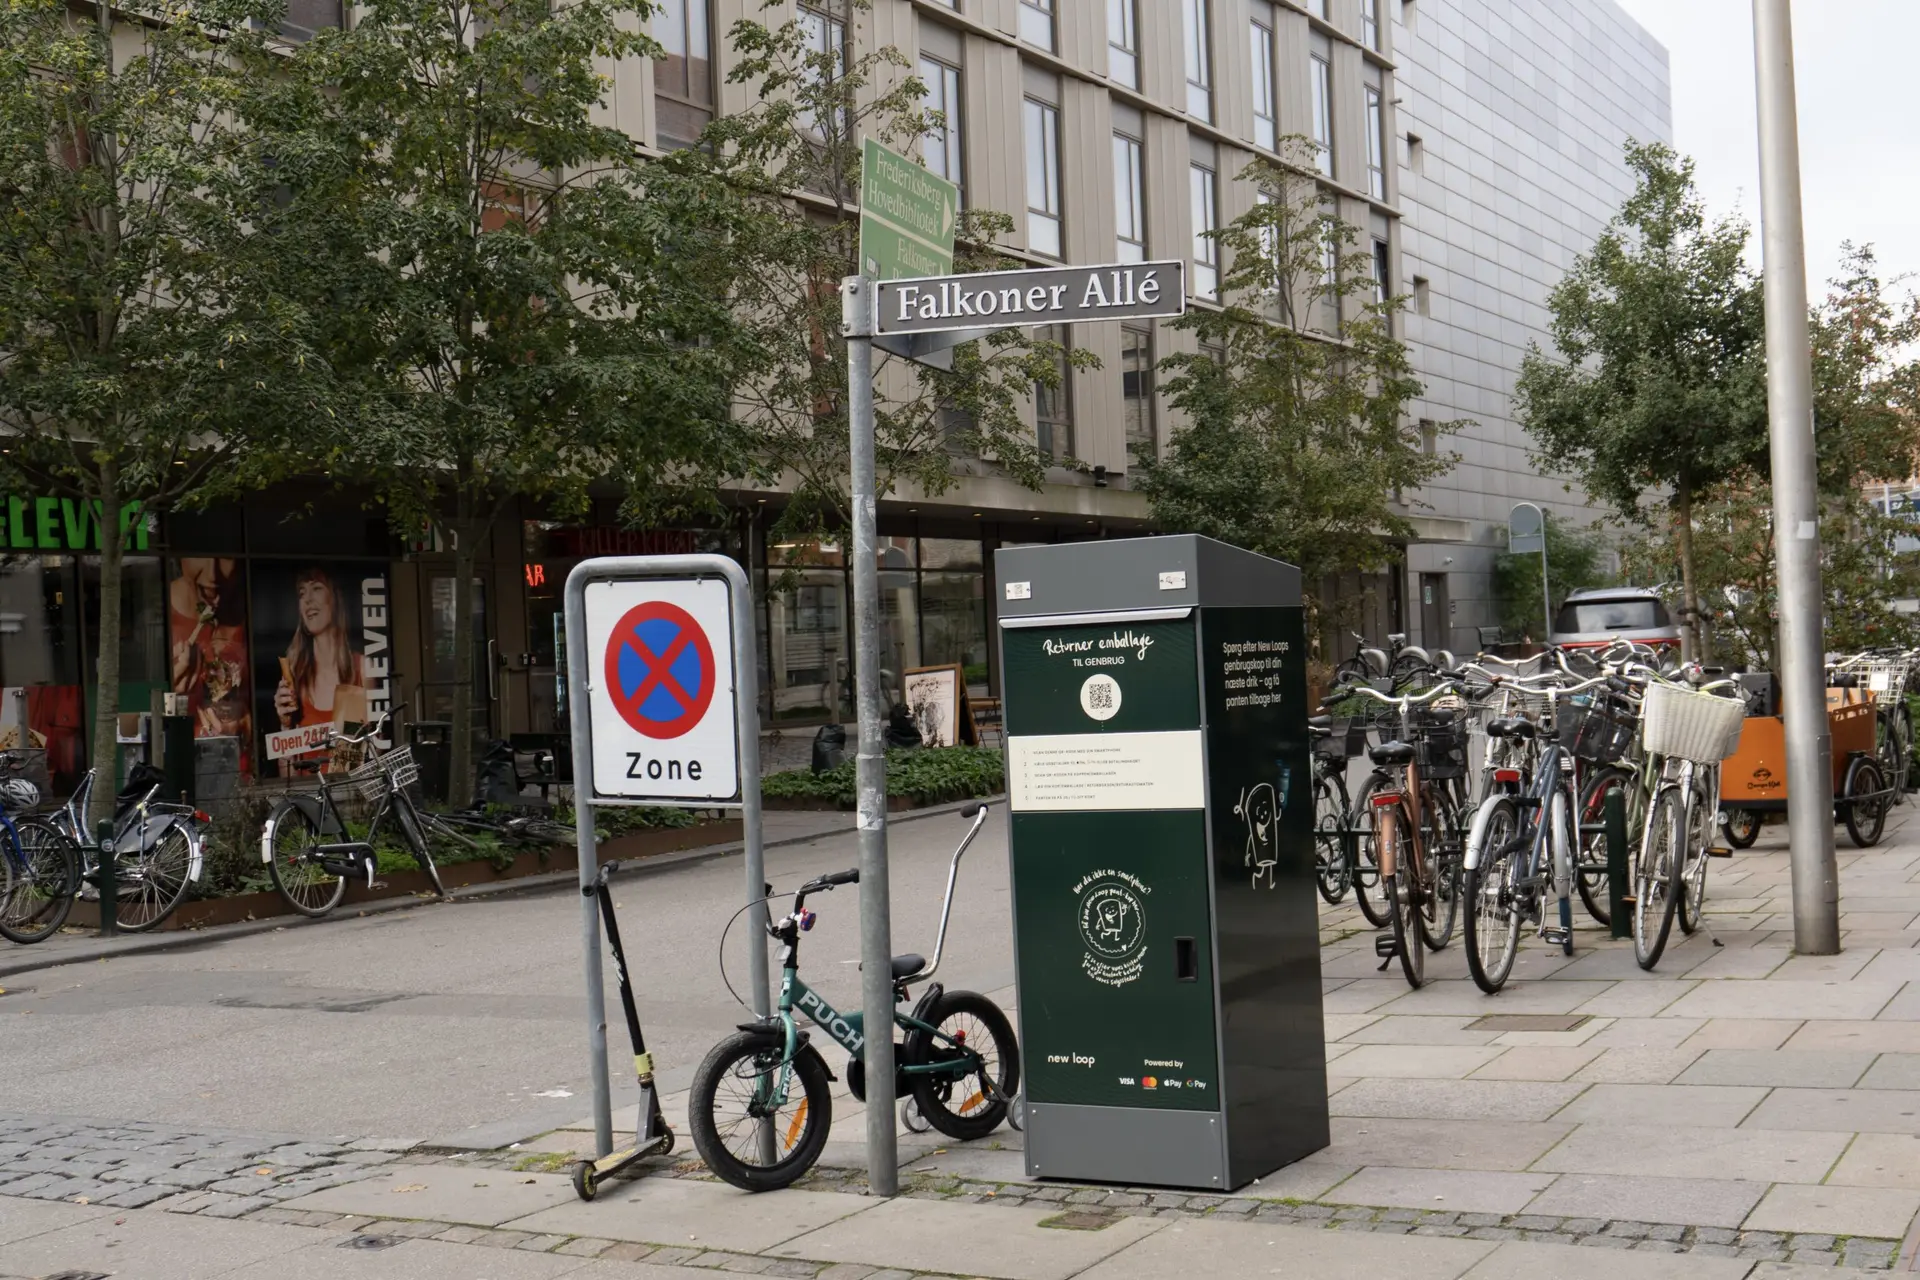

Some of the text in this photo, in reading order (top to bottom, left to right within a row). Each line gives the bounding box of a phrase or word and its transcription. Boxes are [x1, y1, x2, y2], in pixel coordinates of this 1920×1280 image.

[876, 149, 941, 211] Frederiksberg
[868, 178, 939, 237] Hovedbibliotek
[897, 237, 938, 276] Falkoner
[896, 269, 1161, 322] Falkoner Allé
[1042, 630, 1155, 661] Returner emballage
[1223, 640, 1289, 656] Spørg efter New Loops
[1072, 656, 1125, 667] TIL GENBRUG
[1223, 658, 1265, 675] genbrugskop
[1272, 657, 1282, 669] din
[1225, 677, 1246, 689] næste
[1246, 675, 1258, 688] drik
[1264, 677, 1273, 690] og
[1273, 673, 1280, 686] få
[1226, 692, 1282, 711] panten tilbage her
[273, 736, 302, 755] Open
[626, 752, 702, 781] Zone
[1083, 875, 1093, 886] du
[1091, 869, 1106, 880] ikke
[1107, 869, 1116, 877] en
[798, 990, 865, 1052] PUCH
[1047, 1052, 1095, 1068] new loop
[1144, 1059, 1184, 1069] Powered by
[1118, 1077, 1135, 1085] VISA
[1169, 1080, 1182, 1088] Pay
[1194, 1080, 1207, 1090] Pay
